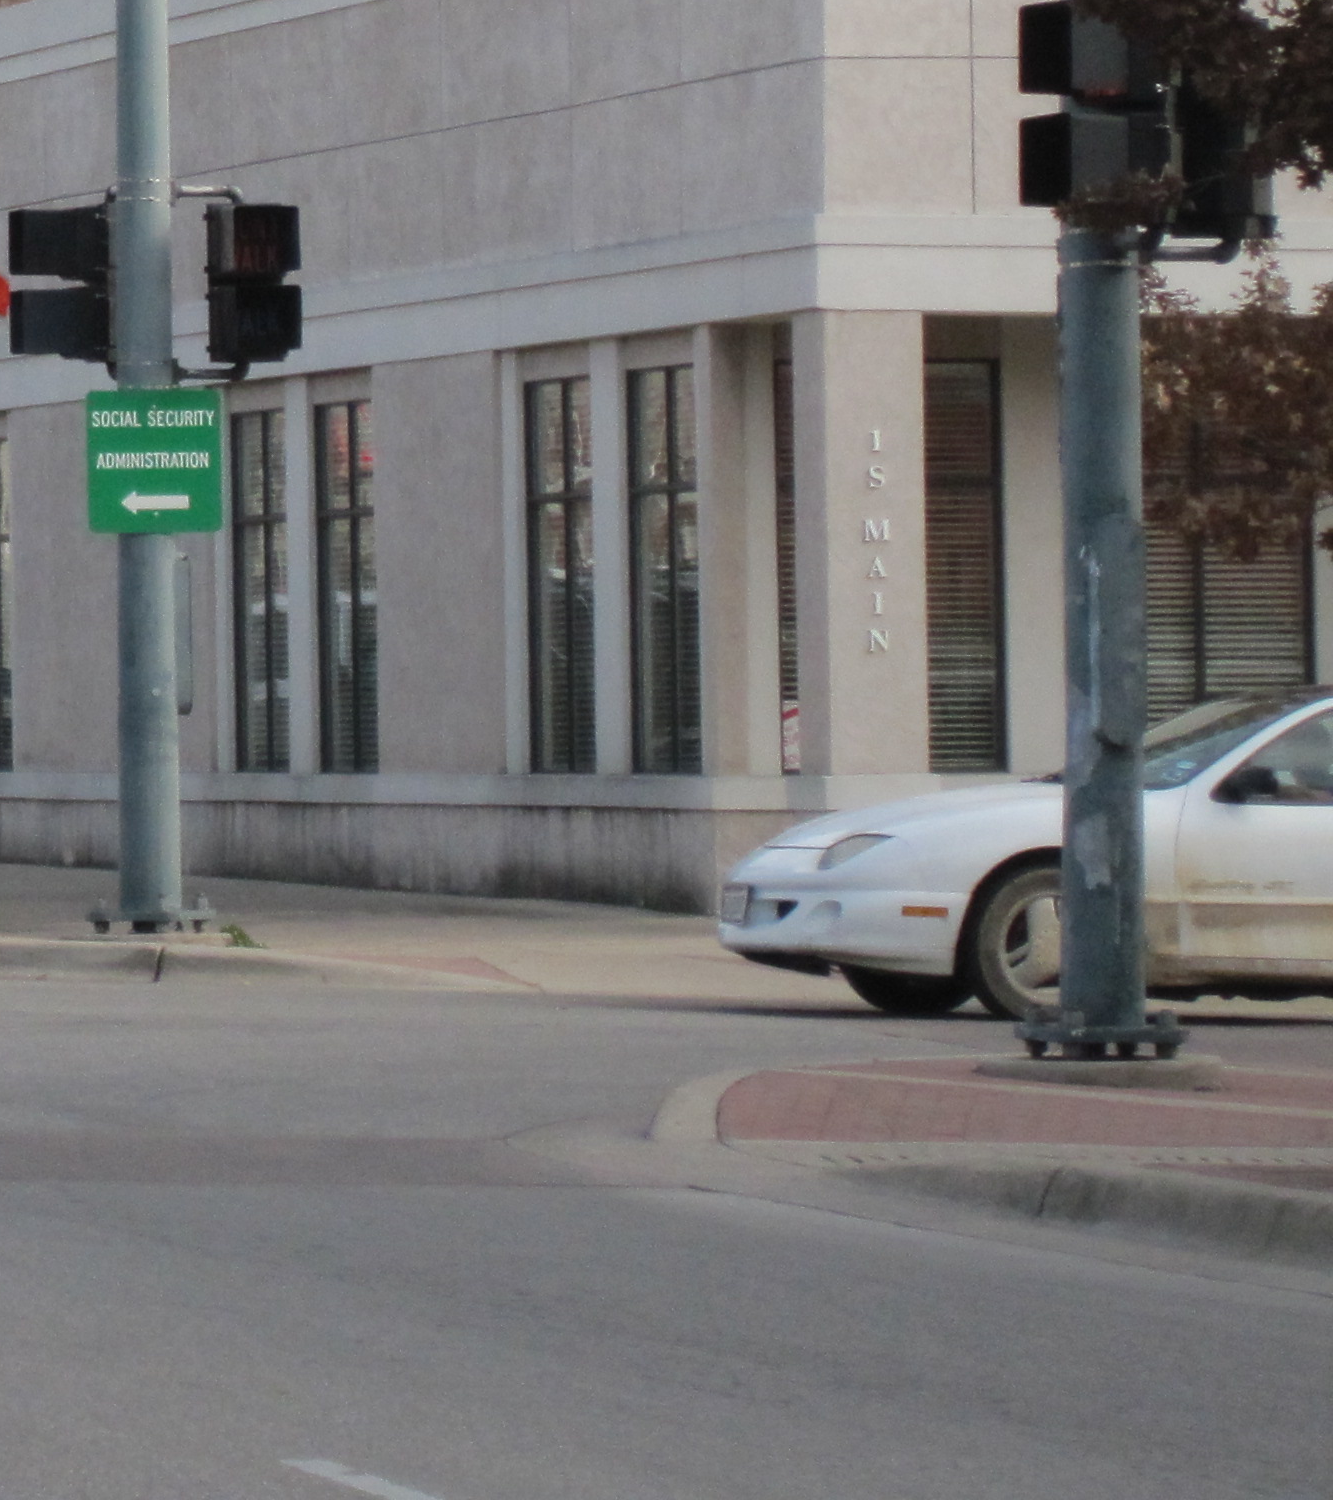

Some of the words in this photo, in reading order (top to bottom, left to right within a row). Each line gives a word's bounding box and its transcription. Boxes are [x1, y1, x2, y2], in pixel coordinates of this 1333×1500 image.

[91, 410, 142, 428] SOCIAL
[147, 409, 215, 428] SECURITY
[96, 451, 210, 470] ADMINISTRATION
